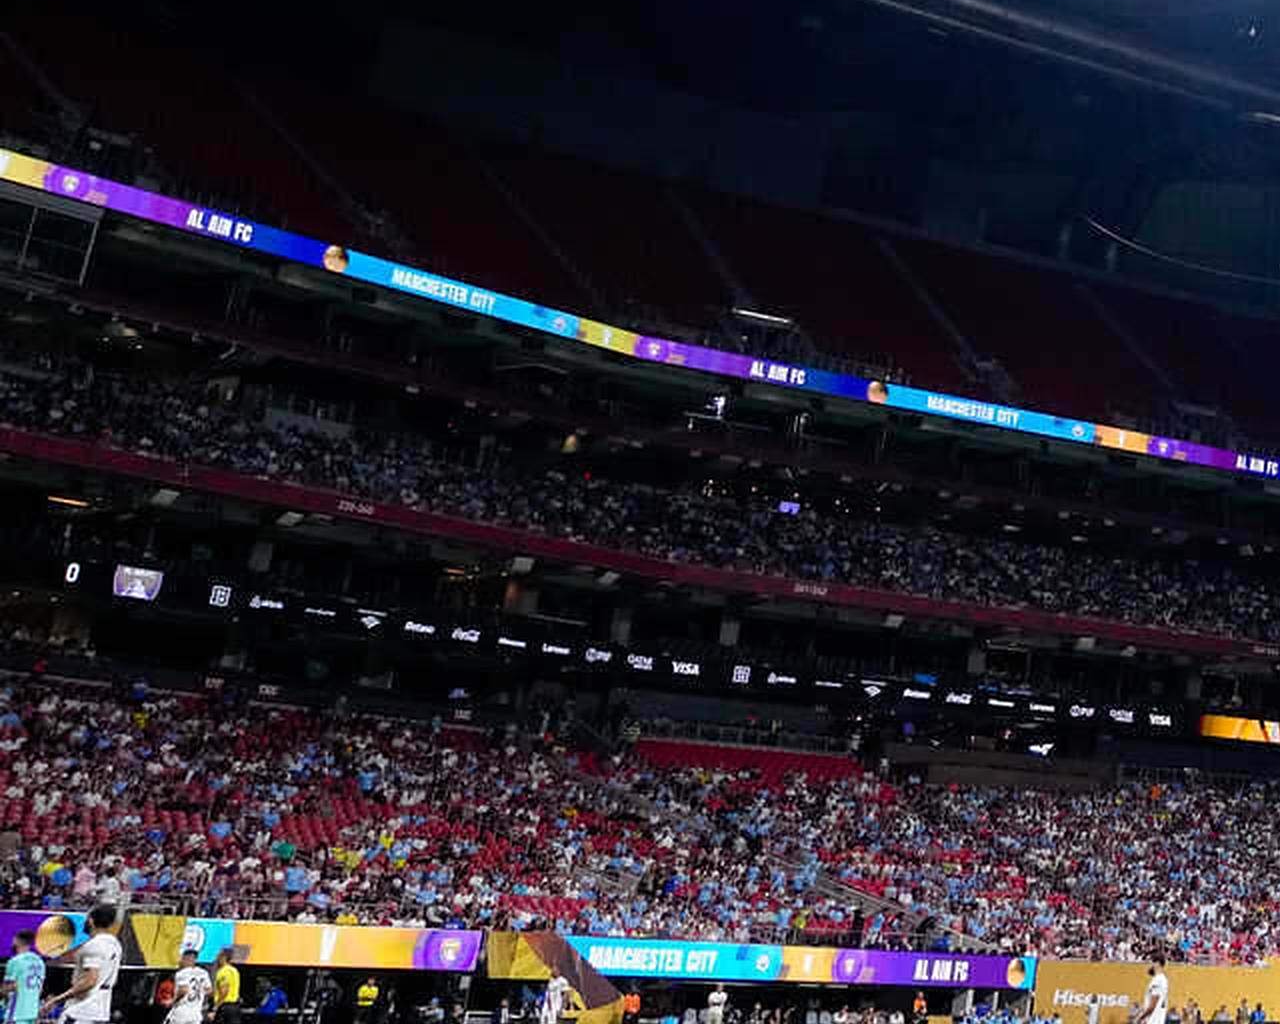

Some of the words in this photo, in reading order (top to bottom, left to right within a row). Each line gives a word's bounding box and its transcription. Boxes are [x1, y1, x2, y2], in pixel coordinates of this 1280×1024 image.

[187, 208, 204, 229] AL
[234, 221, 253, 243] FC
[392, 268, 468, 305] MANCHESTER
[749, 360, 765, 378] AL
[789, 367, 806, 385] FC
[66, 563, 80, 582] 0
[672, 661, 699, 675] VISA
[589, 946, 684, 972] MANCHESTER
[686, 950, 718, 973] CITY
[913, 959, 929, 981] AL
[931, 960, 951, 981] AIN
[953, 960, 969, 981] FC
